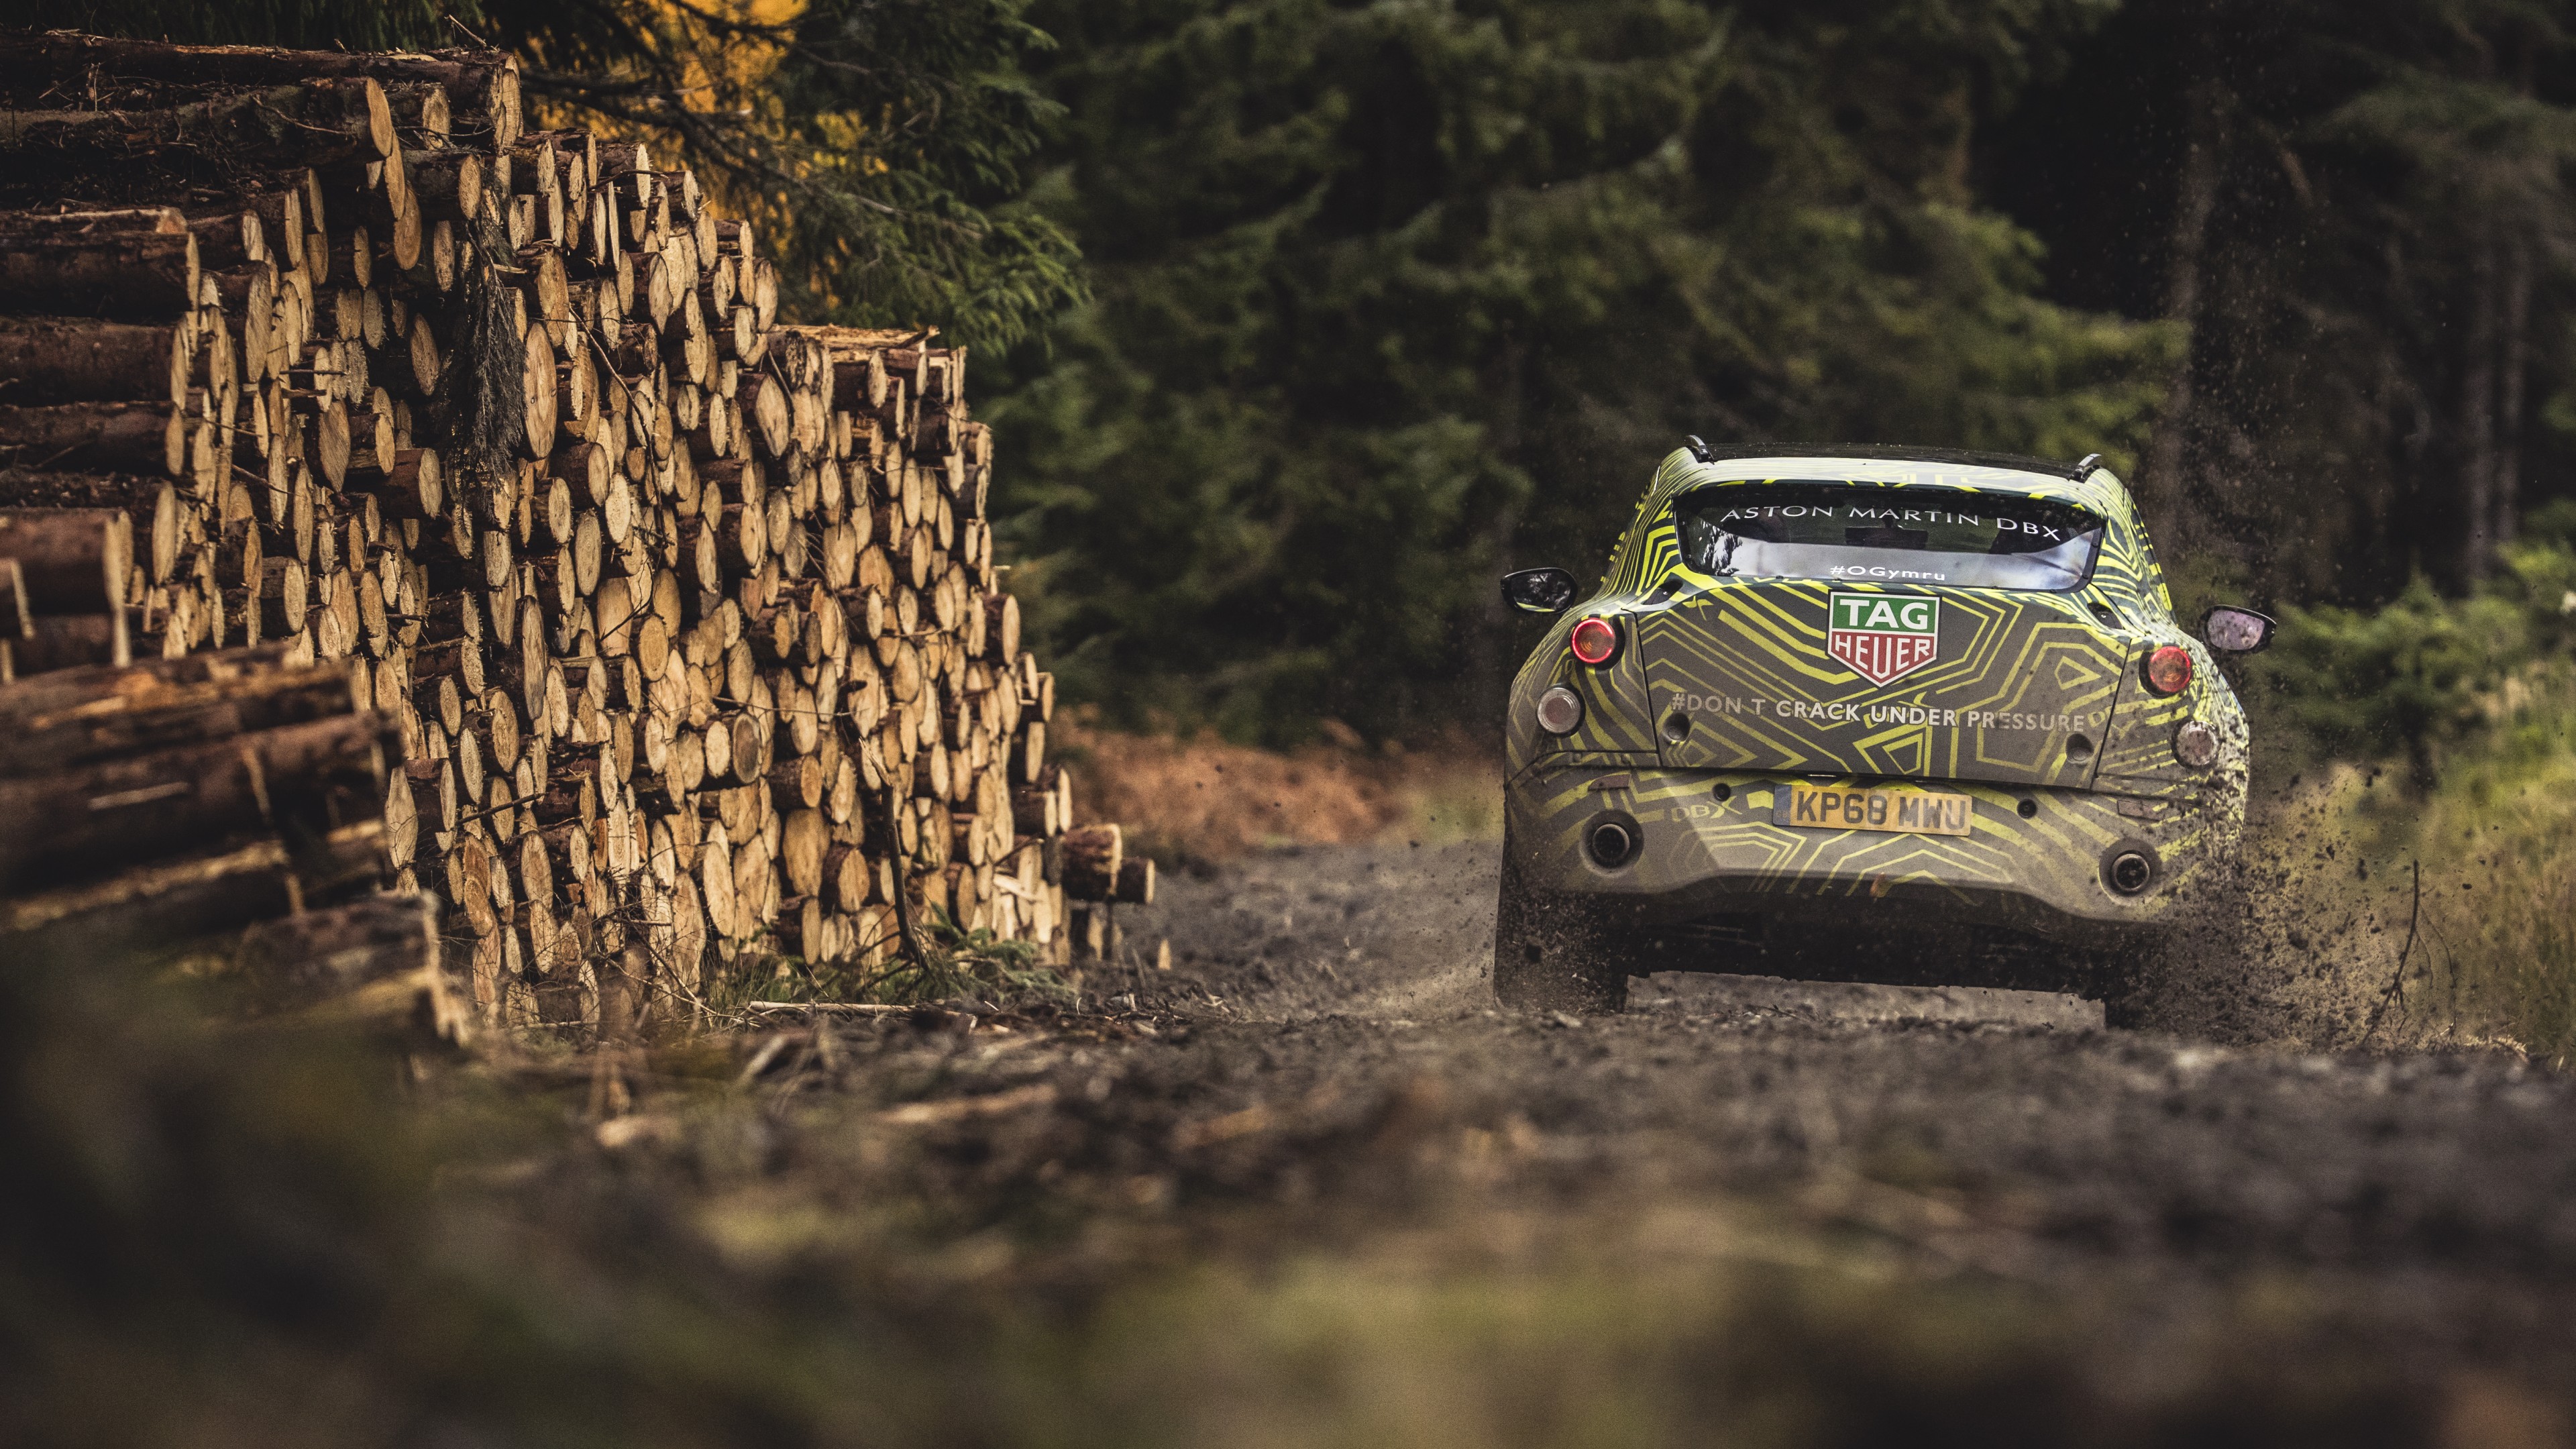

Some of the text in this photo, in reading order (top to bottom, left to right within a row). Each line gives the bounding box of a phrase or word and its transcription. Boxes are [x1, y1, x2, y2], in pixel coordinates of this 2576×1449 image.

[1720, 506, 2060, 541] ASTON MARTIN DBX
[1830, 566, 1945, 580] #OGymru
[1839, 598, 1928, 629] TAG
[1835, 635, 1931, 679] HEUER
[1776, 700, 1860, 721] CRACK
[1871, 705, 1956, 727] UNDER
[1968, 711, 2084, 732] PRESSURE
[1796, 791, 1966, 830] KP68 MWU
